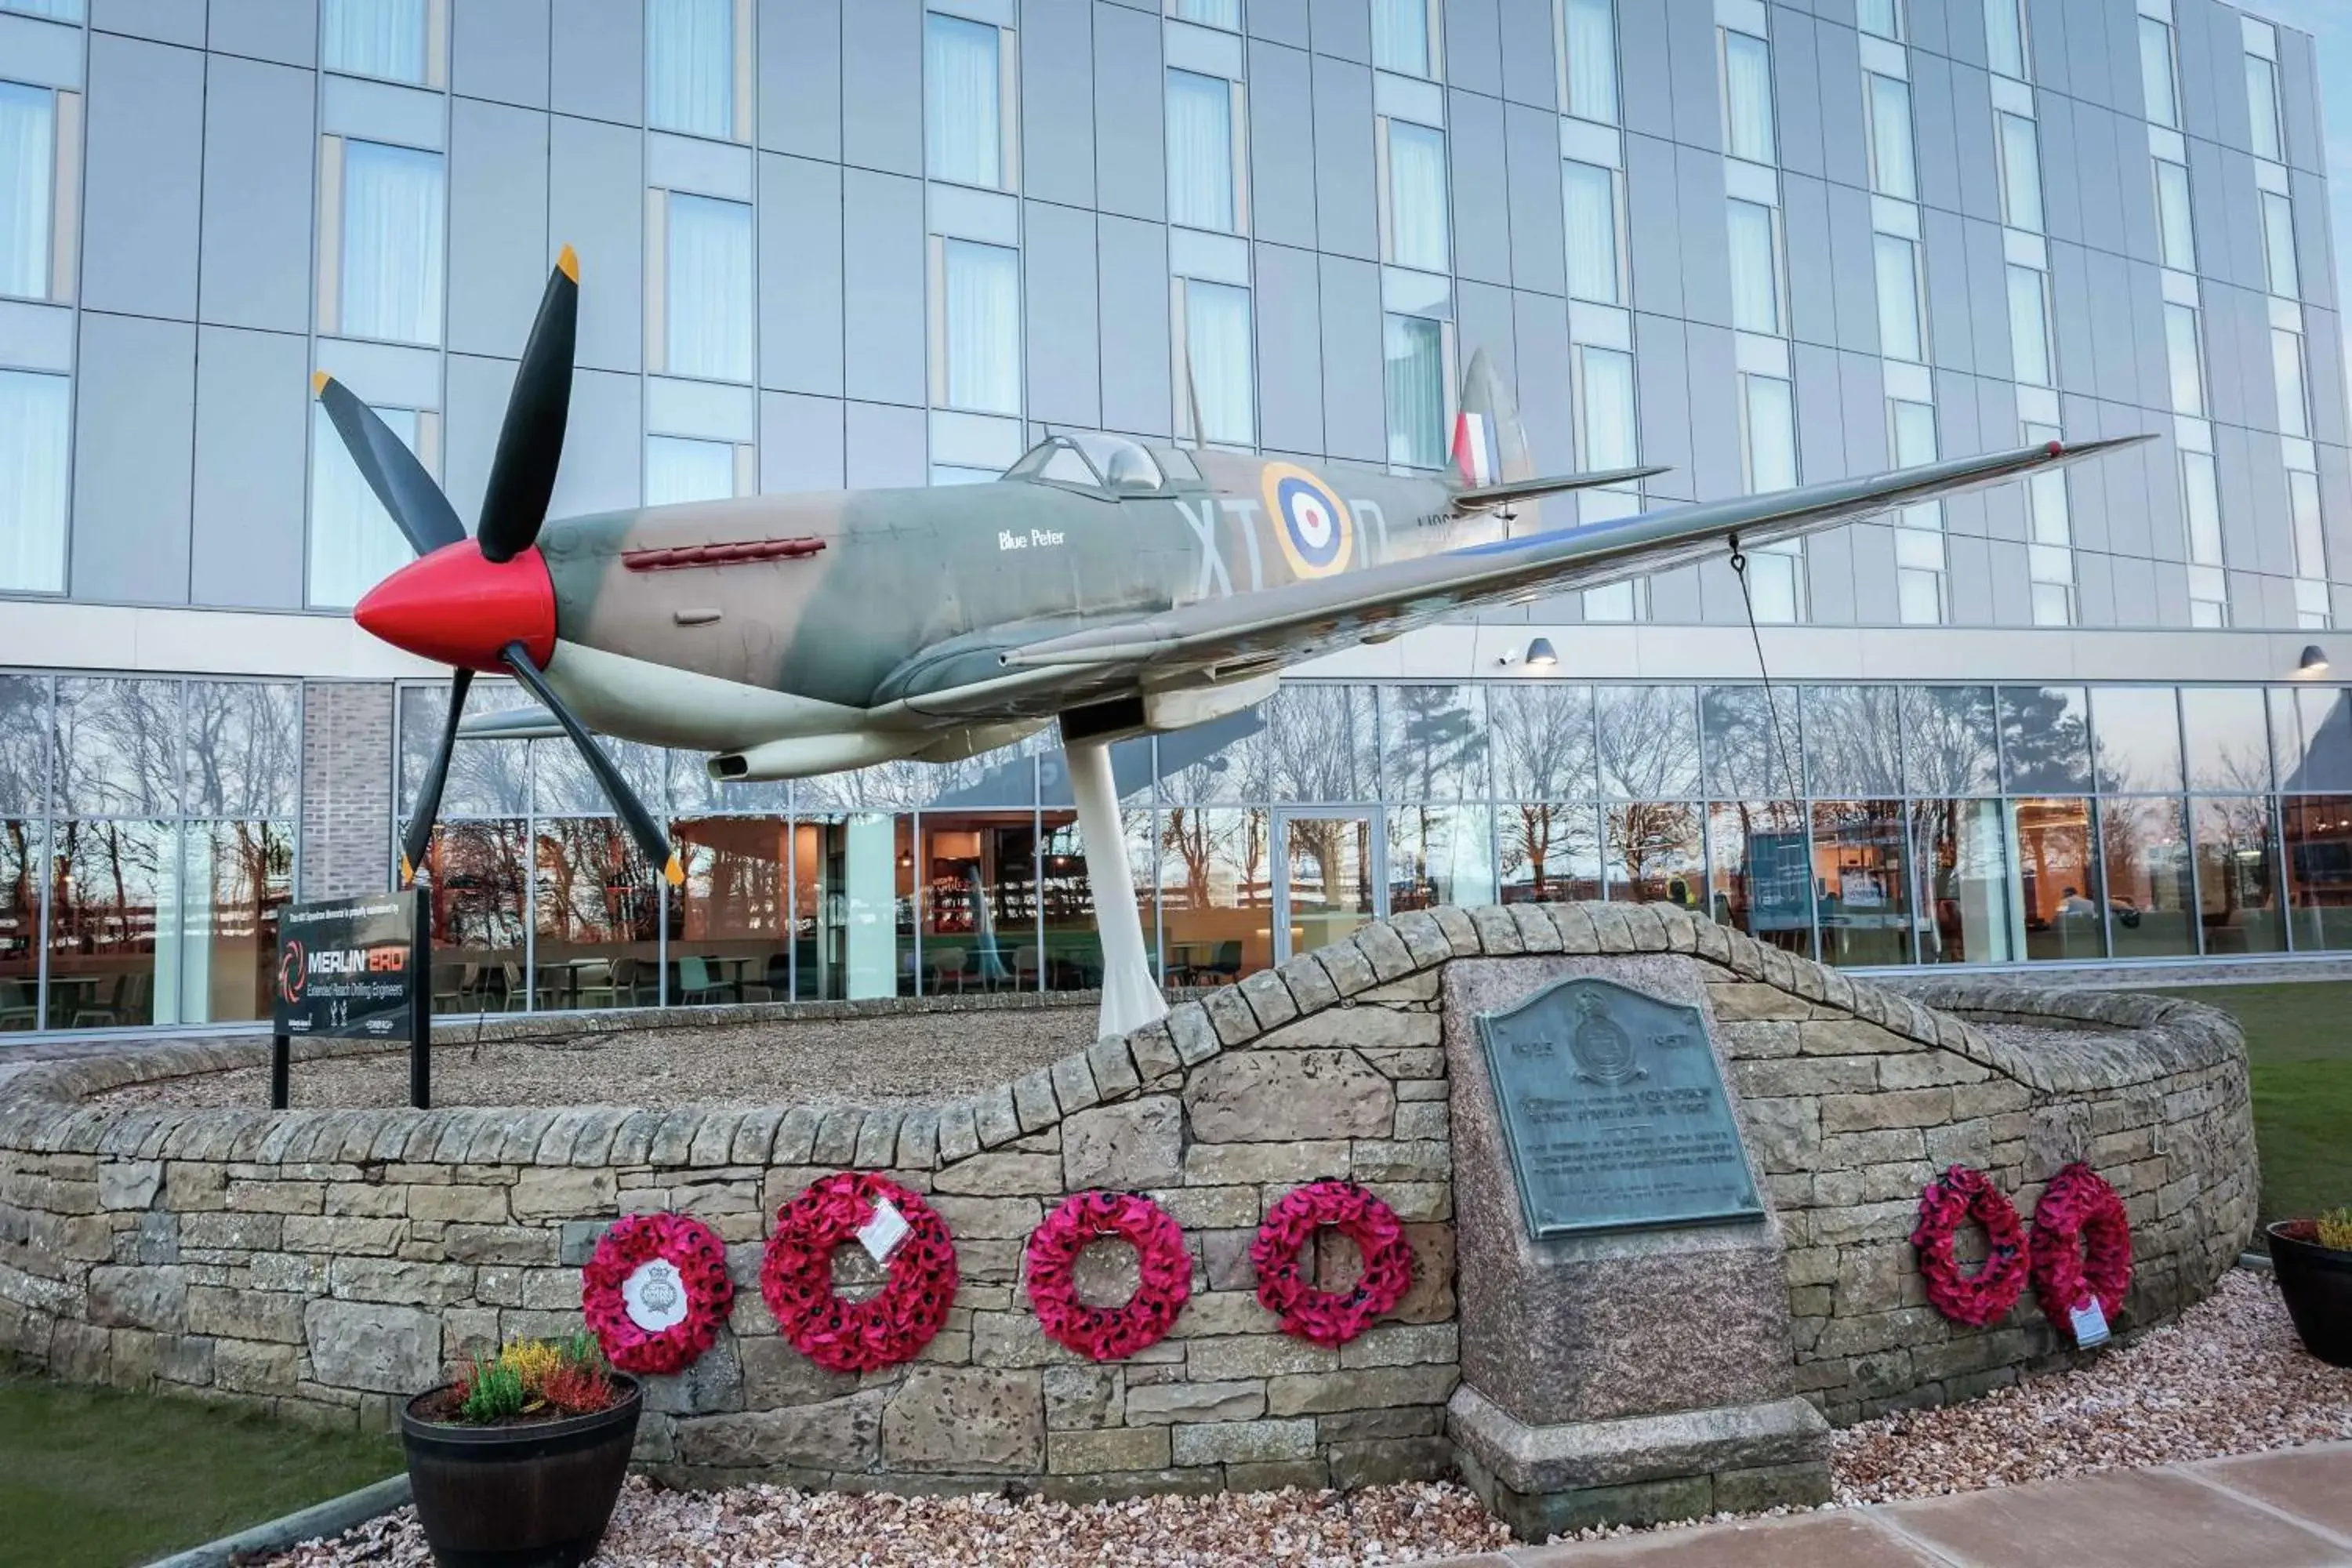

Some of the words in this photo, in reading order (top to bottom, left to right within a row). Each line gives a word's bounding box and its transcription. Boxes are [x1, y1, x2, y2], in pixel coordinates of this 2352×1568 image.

[999, 529, 1027, 550] Blue
[1031, 528, 1065, 547] Peter
[1173, 499, 1263, 599] XT
[308, 949, 365, 973] MERLIN
[370, 947, 402, 971] ERD
[307, 982, 331, 996] Extended
[332, 982, 350, 996] Reach
[350, 981, 372, 1000] Drilling
[372, 981, 403, 1000] Engineers
